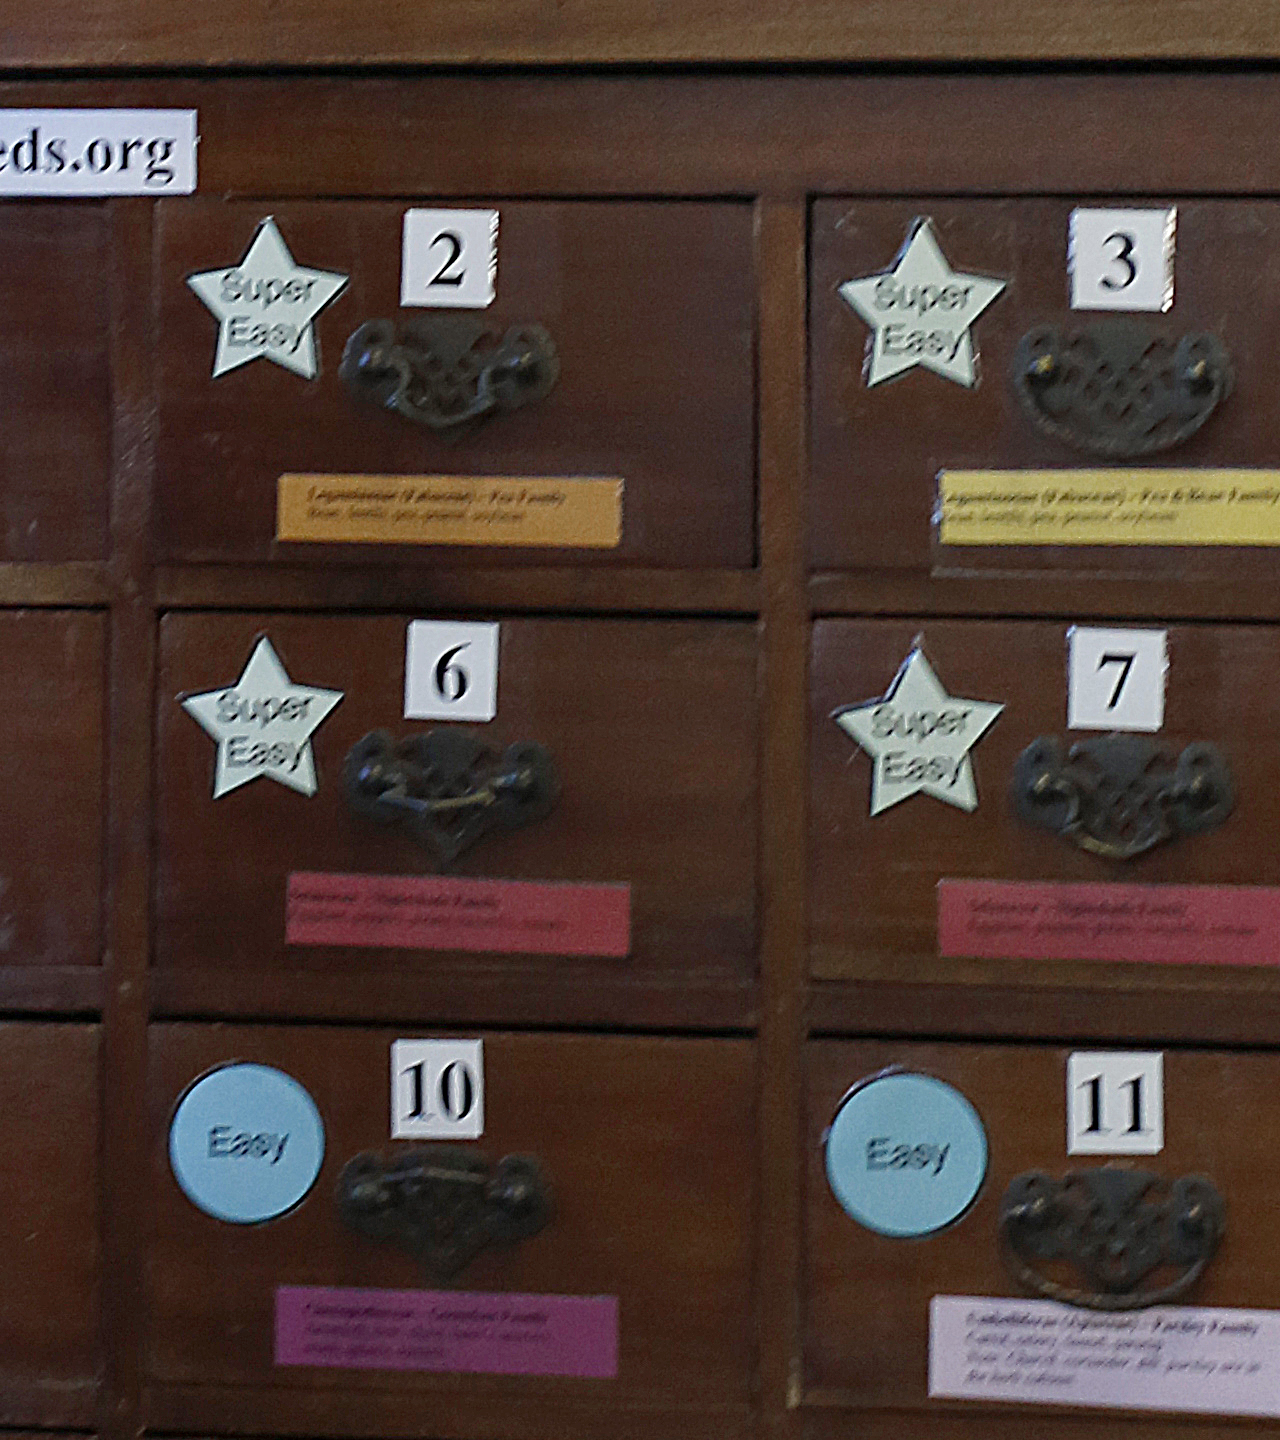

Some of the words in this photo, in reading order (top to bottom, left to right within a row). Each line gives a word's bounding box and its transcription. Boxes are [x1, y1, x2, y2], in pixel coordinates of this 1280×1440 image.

[426, 232, 467, 288] 2
[1100, 232, 1138, 291] 3
[220, 274, 315, 310] Super
[873, 279, 975, 315] Super
[226, 316, 304, 354] Easy
[880, 321, 966, 362] Easy
[432, 641, 473, 702] 6
[1096, 652, 1138, 712] 7
[215, 691, 316, 730] Super
[871, 704, 973, 740] Super
[225, 736, 312, 773] Easy
[881, 749, 966, 787] Easy
[398, 1059, 475, 1121] 10
[1075, 1072, 1155, 1137] 11
[207, 1124, 292, 1165] Easy
[864, 1136, 952, 1178] Easy
